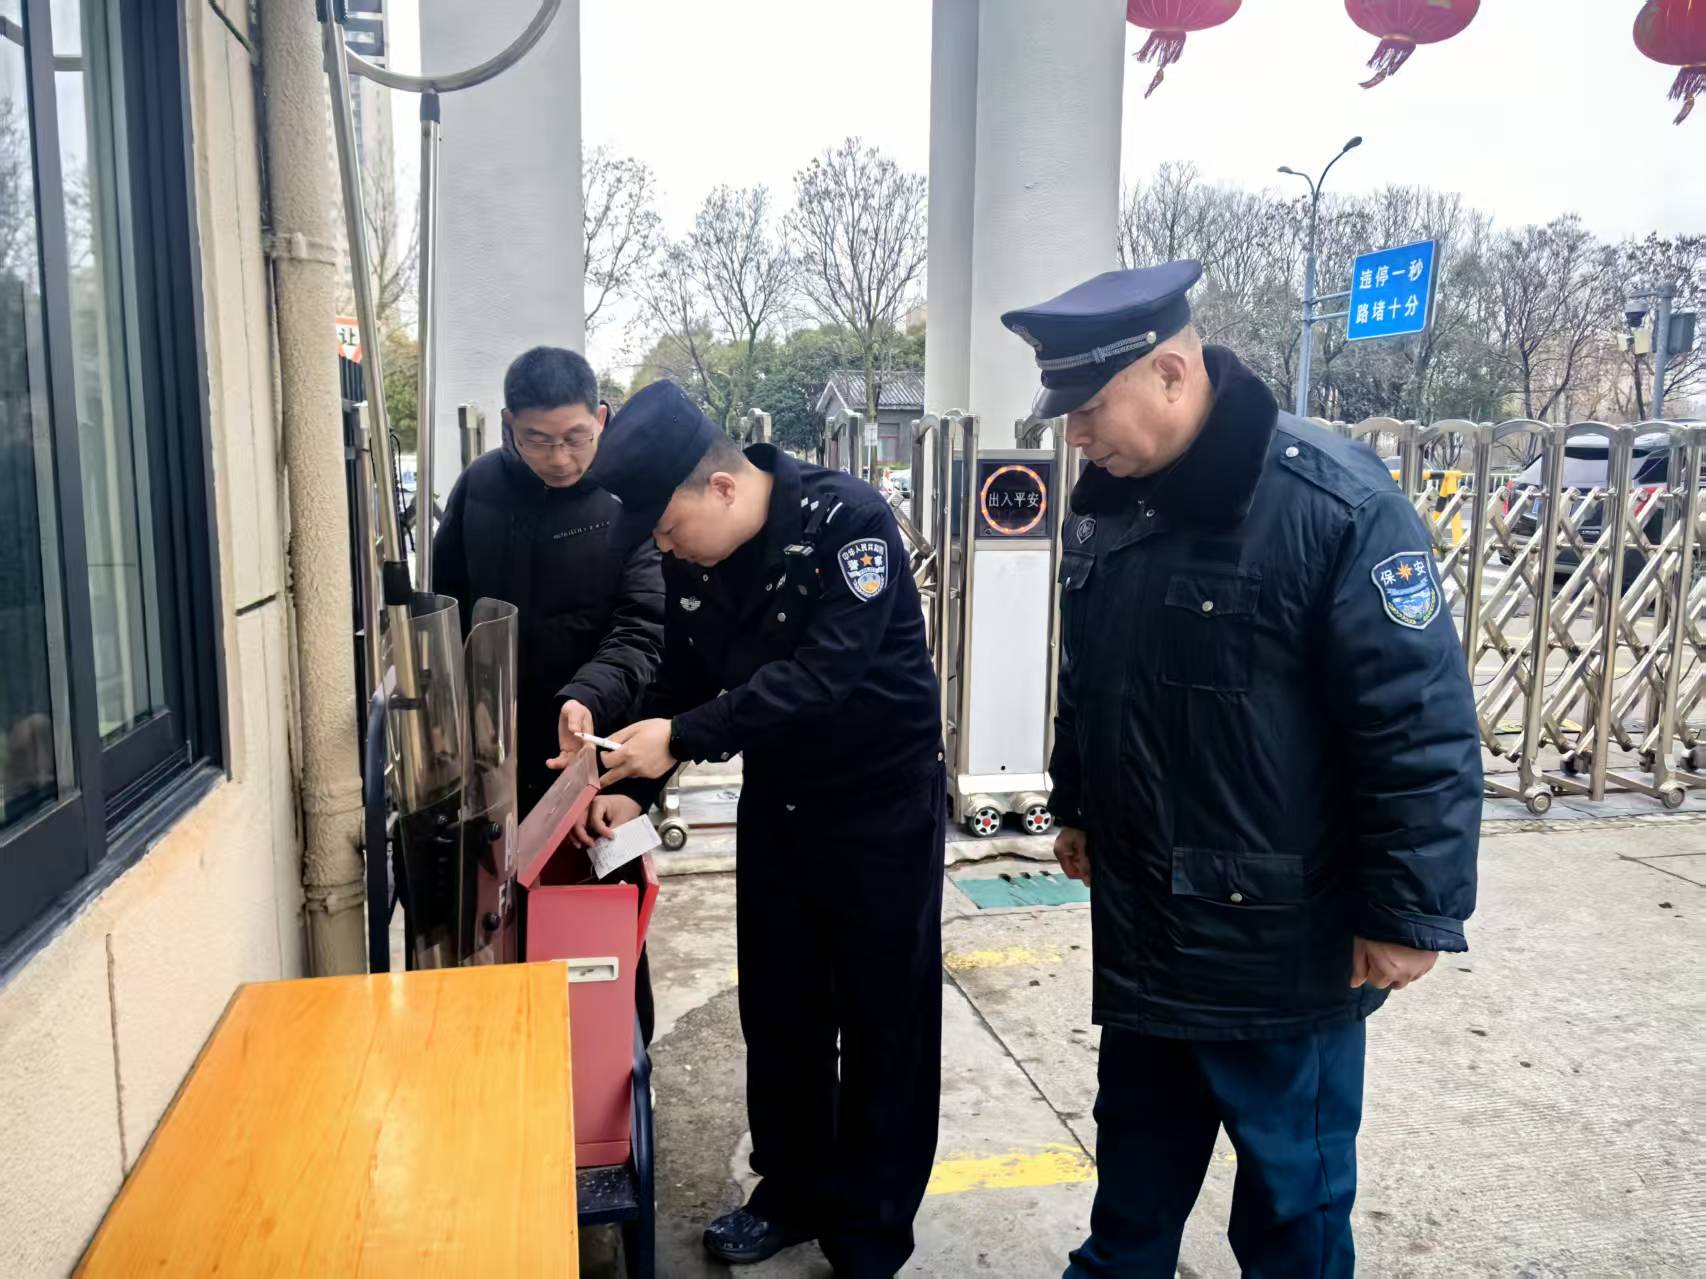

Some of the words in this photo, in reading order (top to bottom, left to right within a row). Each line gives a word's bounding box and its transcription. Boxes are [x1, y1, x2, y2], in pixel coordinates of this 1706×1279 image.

[1359, 258, 1424, 289] 违停一秒
[1355, 294, 1419, 324] 路堵十分
[338, 327, 357, 346] 让
[988, 491, 1039, 508] 出入平安
[1380, 561, 1427, 586] 保安
